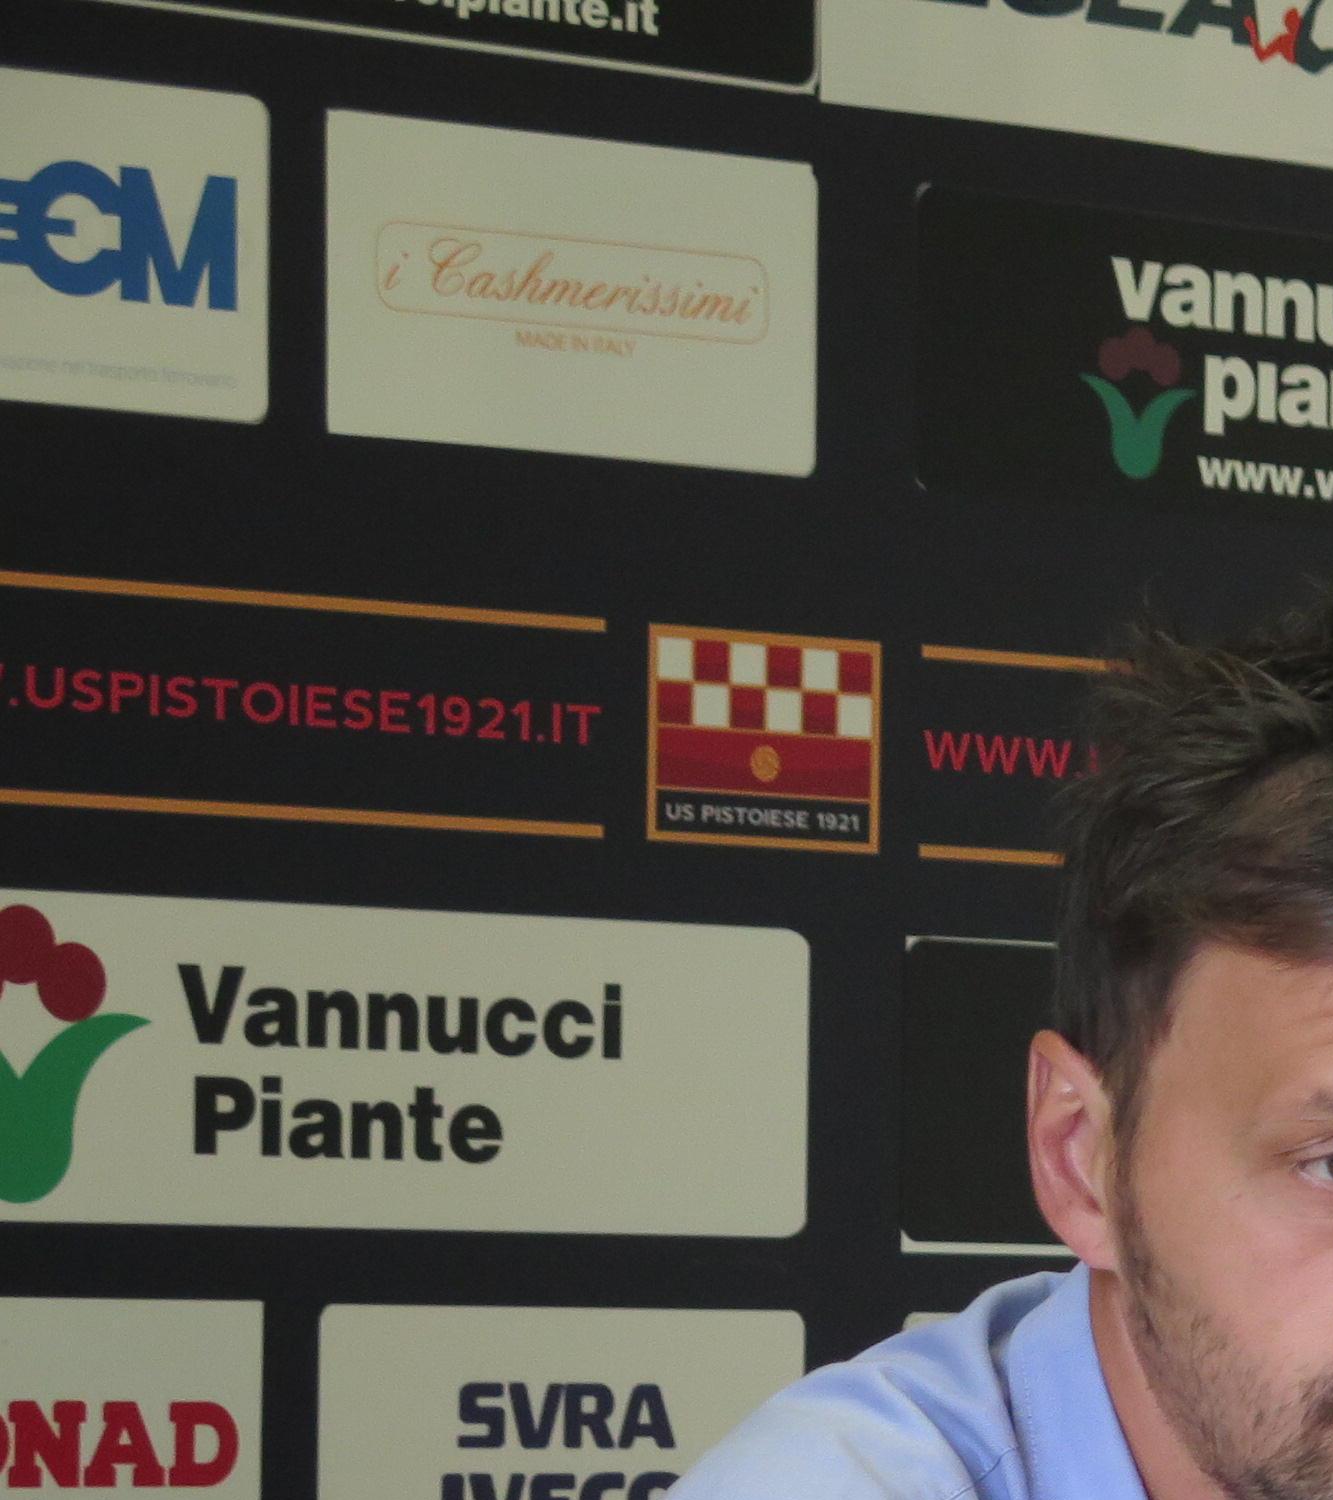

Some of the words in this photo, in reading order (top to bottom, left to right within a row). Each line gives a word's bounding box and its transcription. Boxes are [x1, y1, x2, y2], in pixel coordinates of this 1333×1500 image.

[427, 237, 762, 325] Cashmerissimi
[515, 330, 566, 352] MADE
[592, 336, 637, 358] ITALY
[0, 663, 603, 746] .USPISTOIESE1921.IT
[664, 803, 695, 822] US
[701, 804, 810, 829] PISTOIESE
[816, 811, 861, 832] 1921
[177, 963, 623, 1059] Vannucci
[193, 1076, 503, 1164] Piante
[0, 1400, 240, 1488] NAD
[457, 1382, 677, 1449] SVRA
